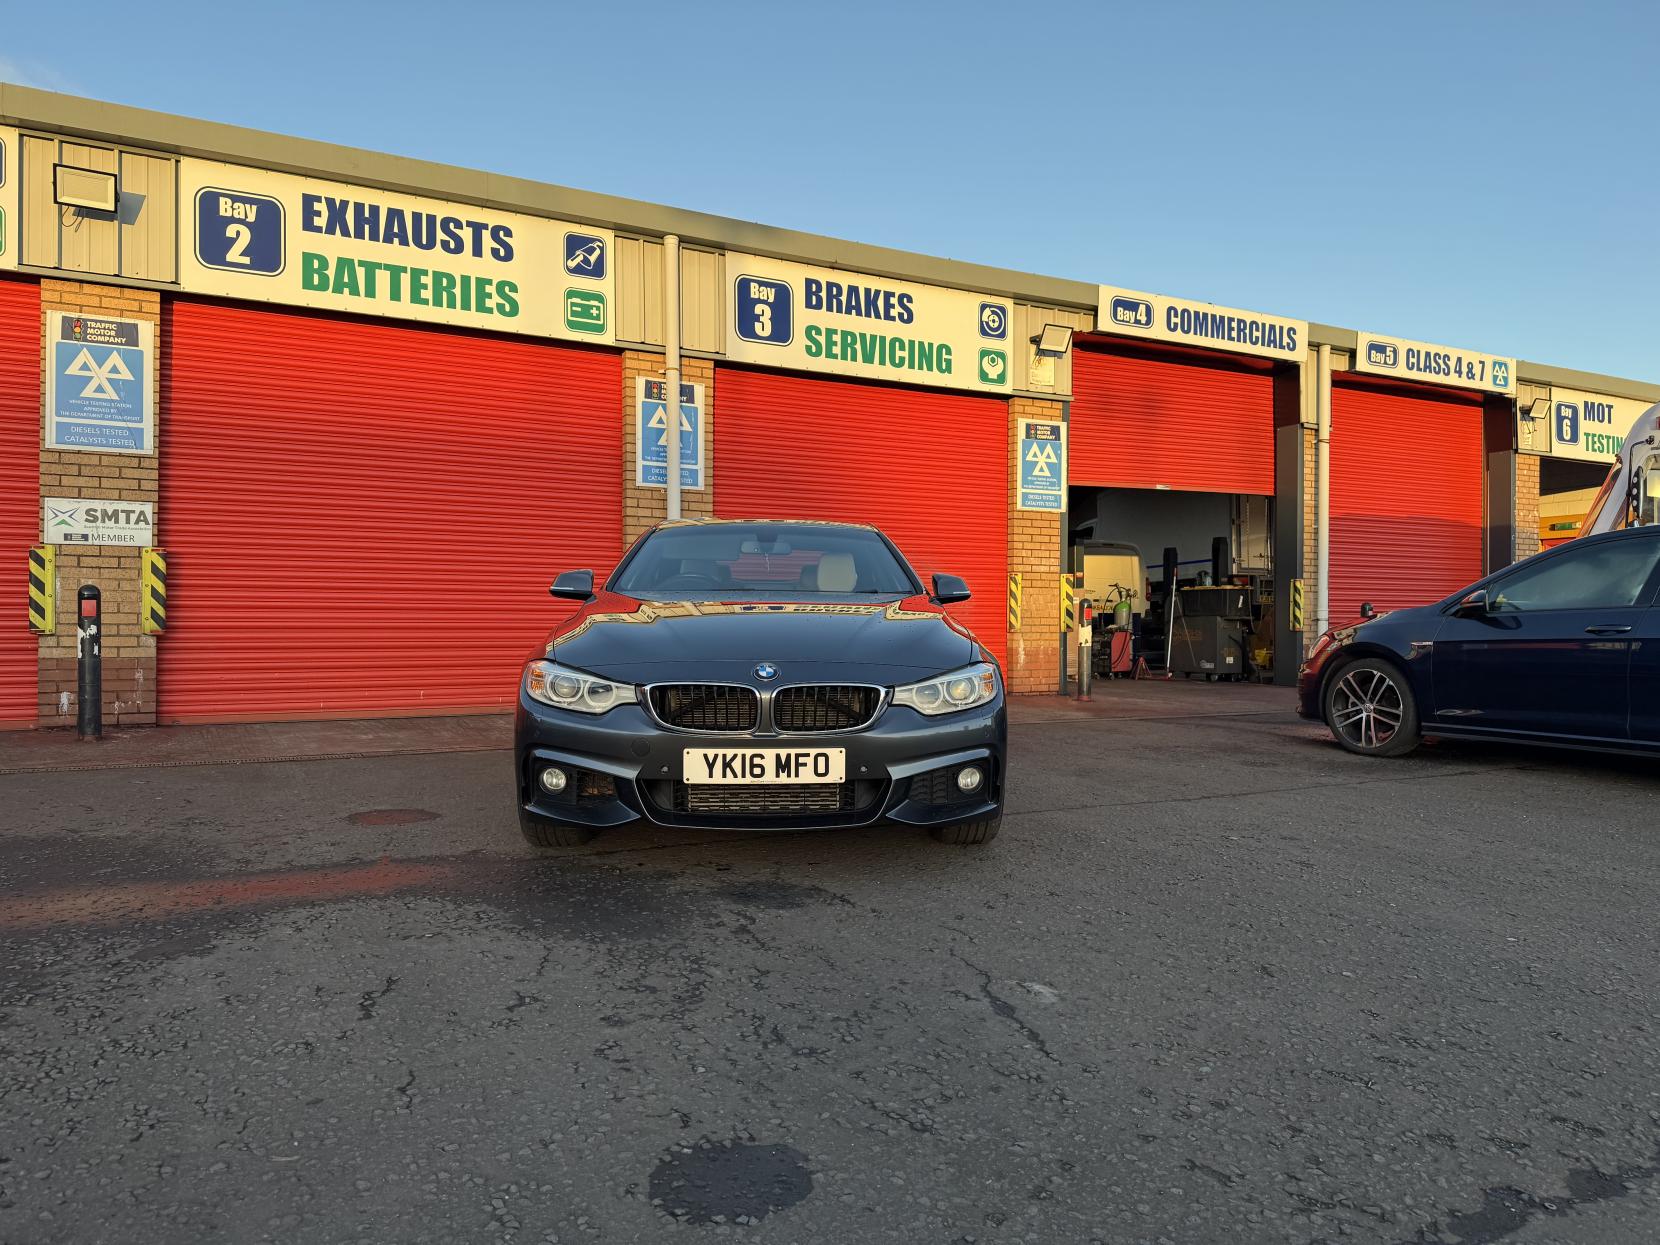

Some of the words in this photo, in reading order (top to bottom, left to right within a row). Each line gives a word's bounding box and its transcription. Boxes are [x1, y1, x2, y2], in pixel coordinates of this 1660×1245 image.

[219, 196, 257, 222] Bay
[302, 193, 514, 262] EXHAUSTS
[225, 223, 251, 264] 2
[302, 251, 520, 317] BATTERIES
[750, 282, 775, 302] Bay
[805, 277, 914, 324] BRAKES
[754, 303, 772, 337] 3
[1166, 306, 1297, 352] COMMERCIALS
[87, 335, 126, 344] COMPANY
[804, 324, 952, 374] SERVICING
[1406, 348, 1450, 376] CLASS
[1454, 357, 1462, 378] 4
[1466, 362, 1476, 380] &
[1479, 360, 1486, 381] 7
[1561, 406, 1572, 418] Bay
[1584, 401, 1613, 424] MOT
[65, 436, 106, 444] CATALYSTS
[1562, 418, 1571, 440] 6
[1584, 432, 1624, 454] TESTIN
[84, 508, 150, 525] SMTA
[92, 533, 135, 542] MEMBER
[703, 753, 765, 778] YK16
[775, 752, 830, 778] MFO
